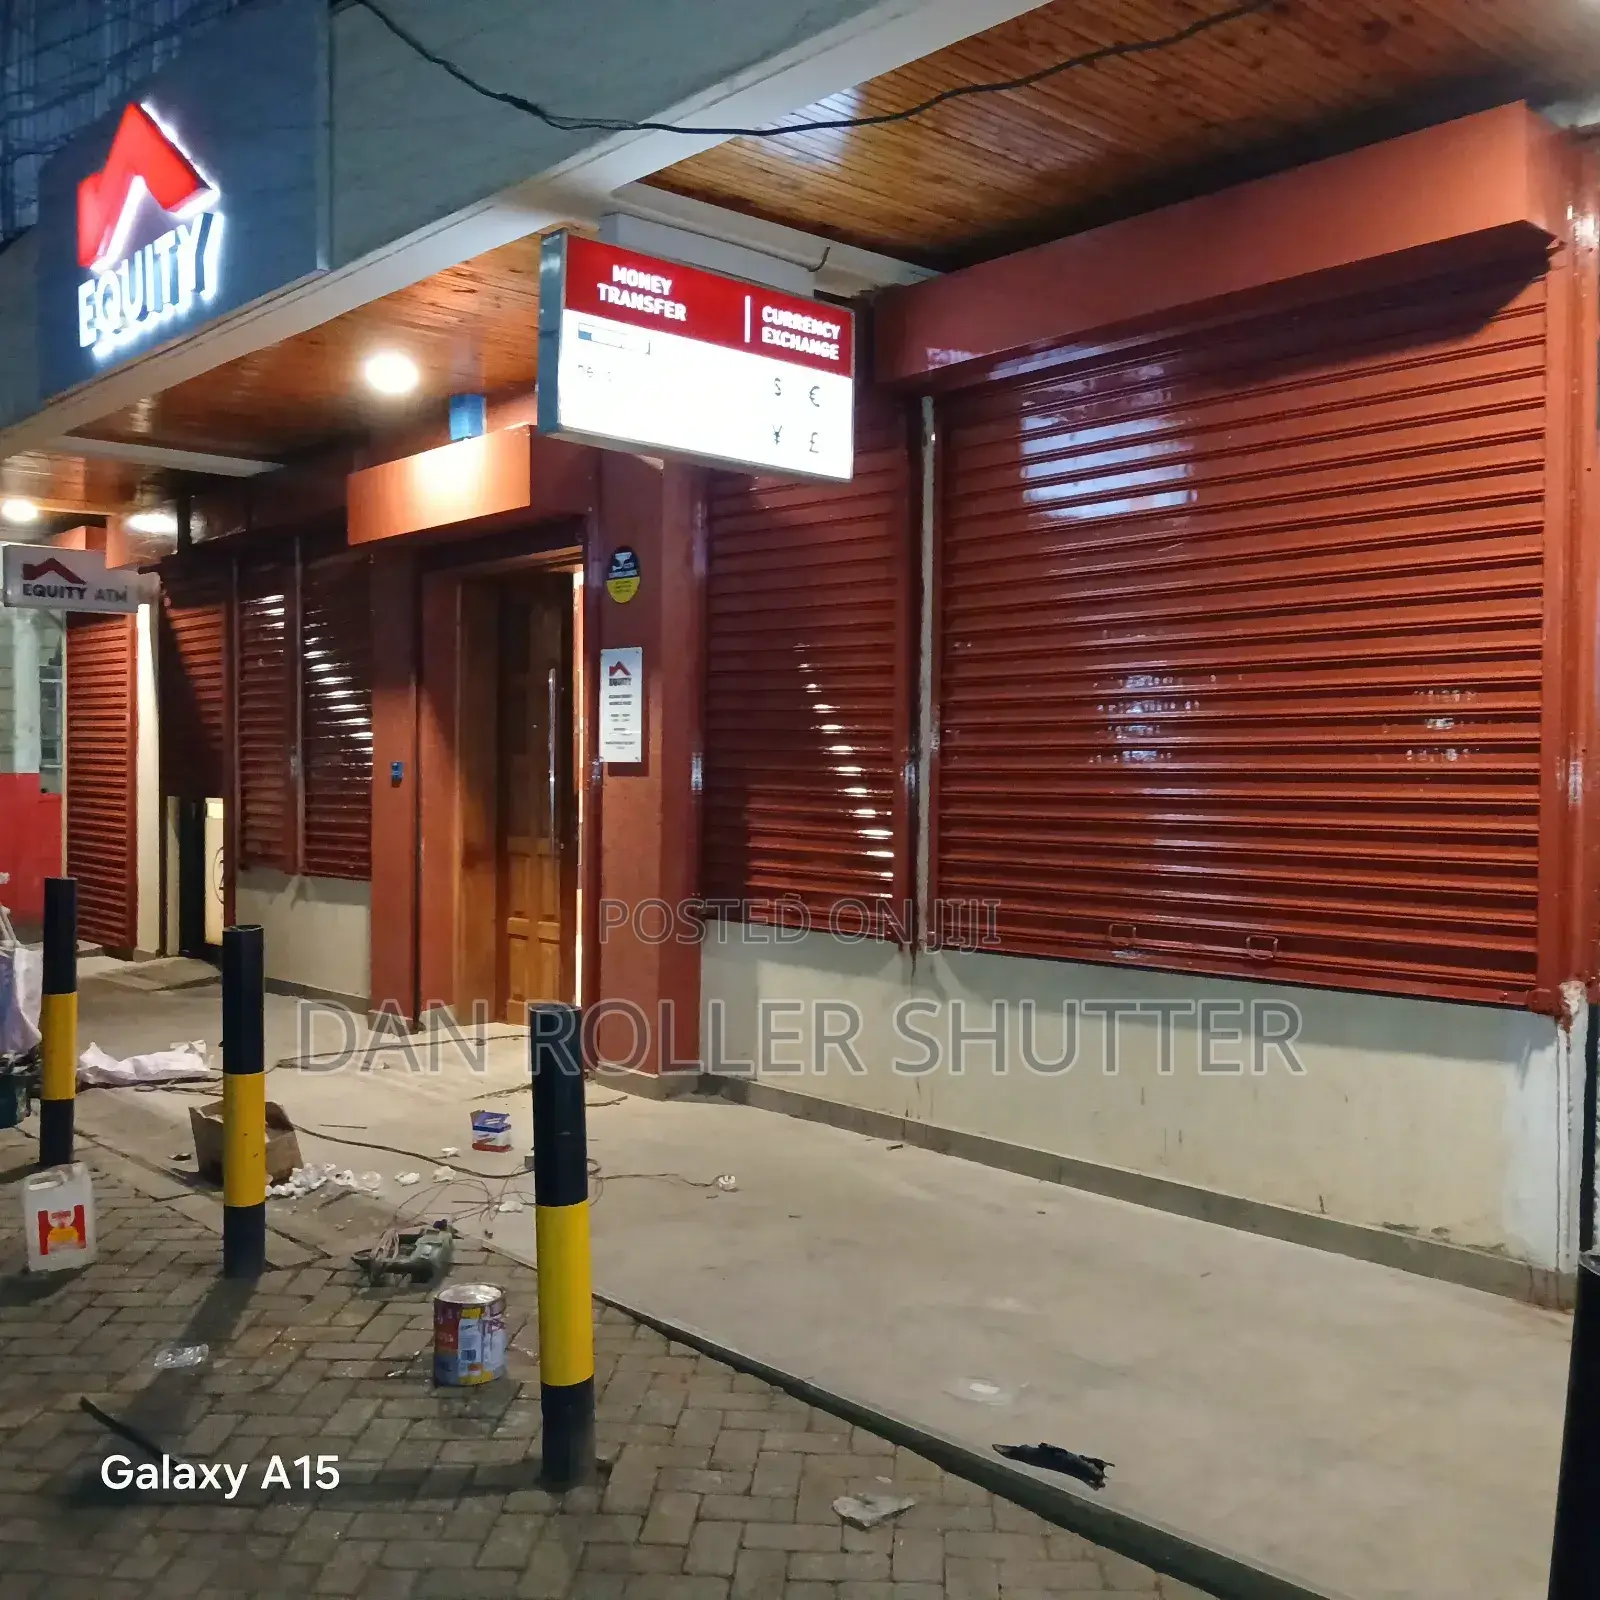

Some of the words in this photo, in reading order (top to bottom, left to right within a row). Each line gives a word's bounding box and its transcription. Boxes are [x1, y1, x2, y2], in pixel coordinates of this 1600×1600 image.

[78, 212, 220, 350] EQUITY
[612, 264, 672, 296] MONEY
[597, 283, 687, 321] TRANSFER
[762, 305, 841, 340] CURRENCY
[762, 327, 840, 360] EXCHANGE
[22, 583, 87, 600] EQUITY
[94, 585, 128, 602] ATM
